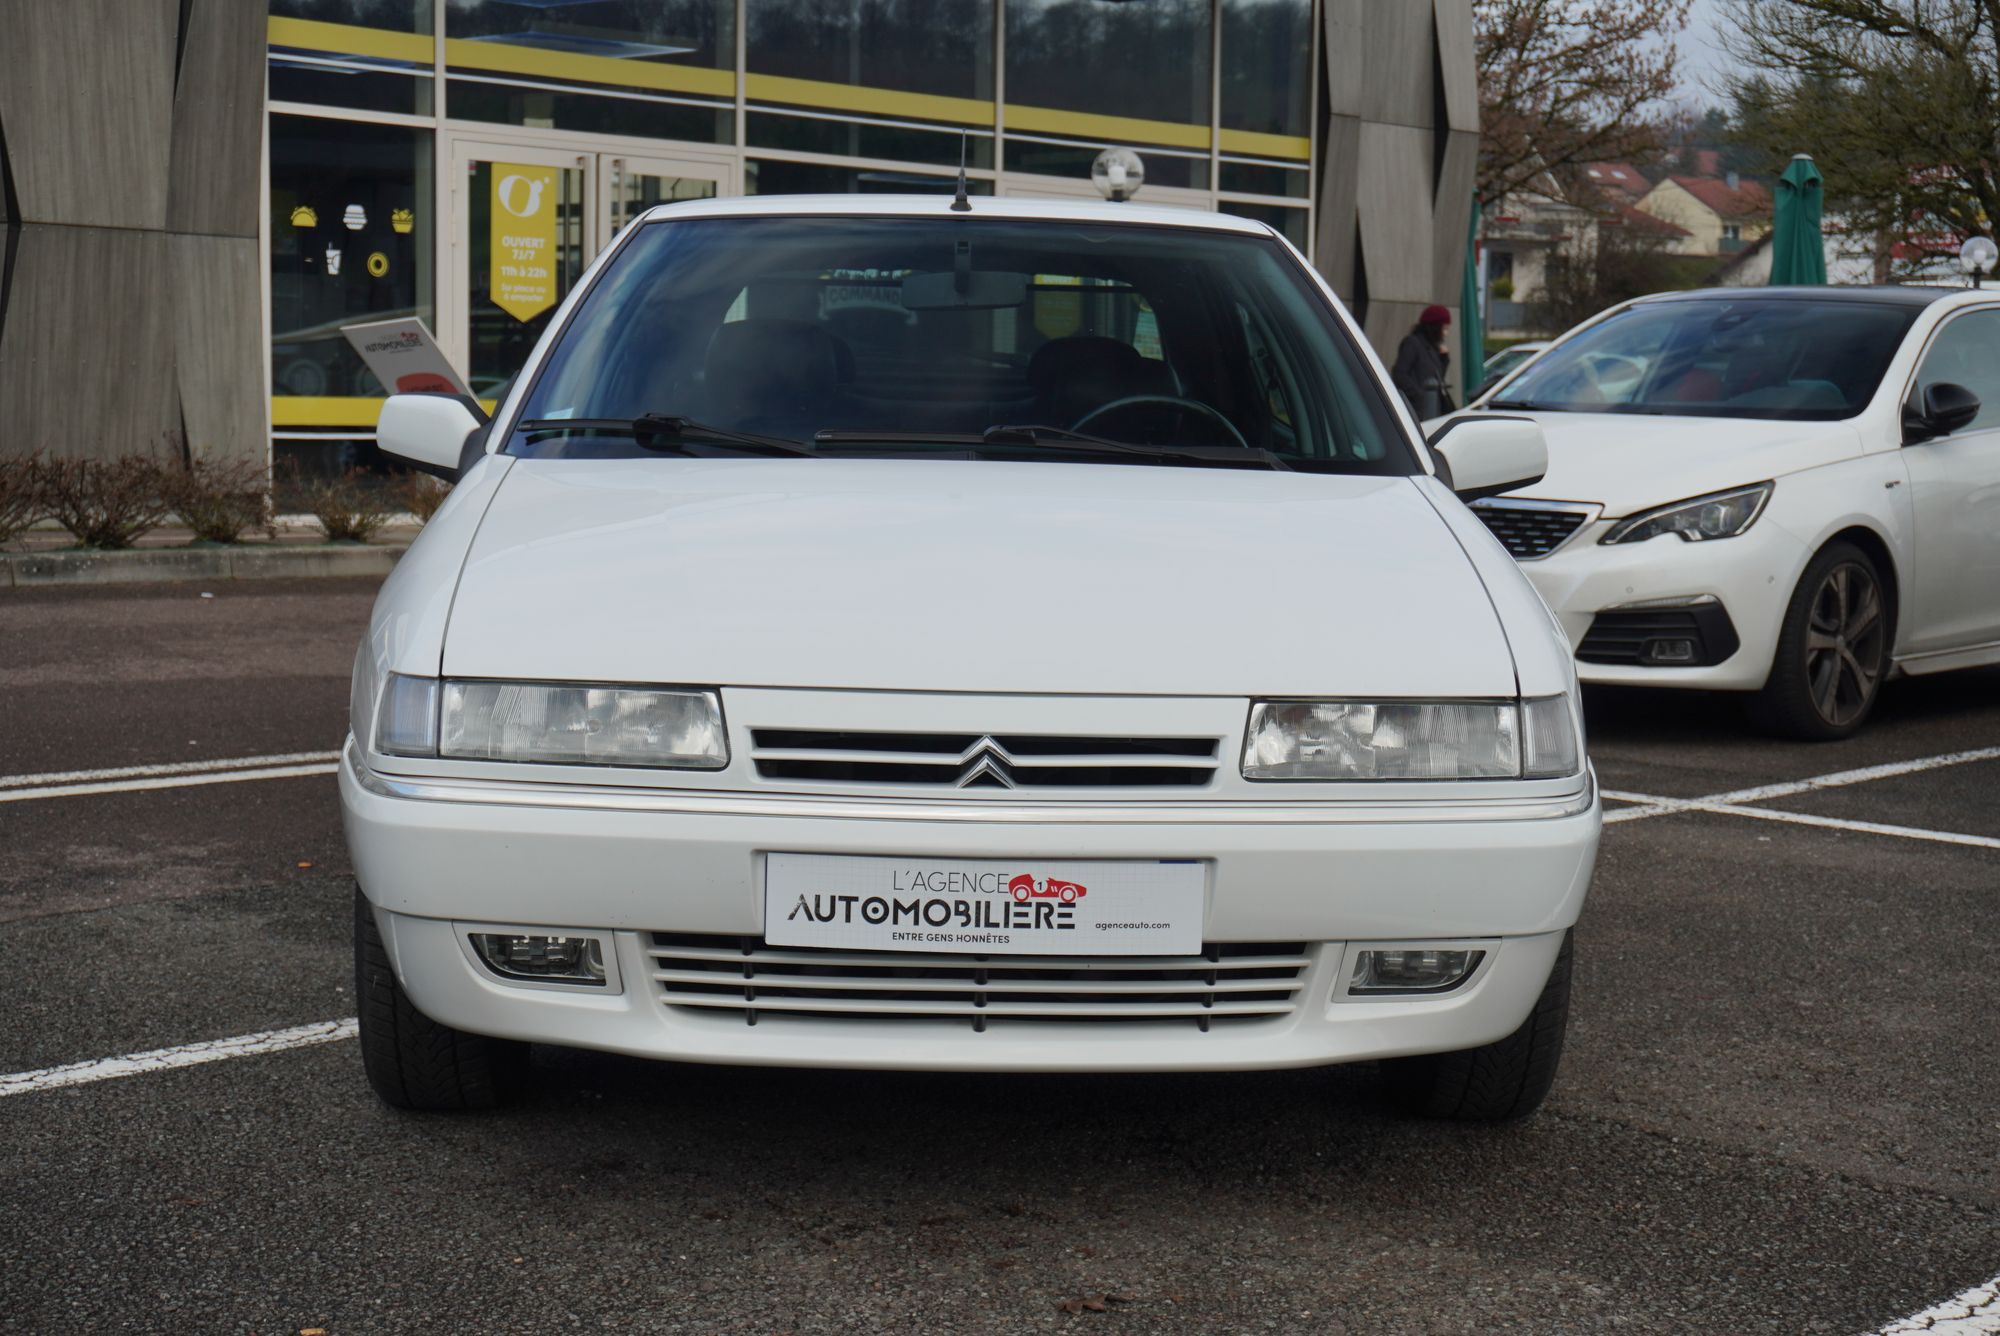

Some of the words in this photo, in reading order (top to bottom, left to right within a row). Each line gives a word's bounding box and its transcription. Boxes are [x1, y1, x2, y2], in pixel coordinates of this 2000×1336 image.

[502, 236, 545, 249] OUVERT
[893, 870, 1010, 894] L'AGENCE
[1037, 881, 1043, 891] 1
[1095, 922, 1170, 931] agenceauto.com
[892, 932, 924, 942] ENTRE
[926, 933, 954, 943] GENS
[956, 932, 1010, 944] HONNÊTES
